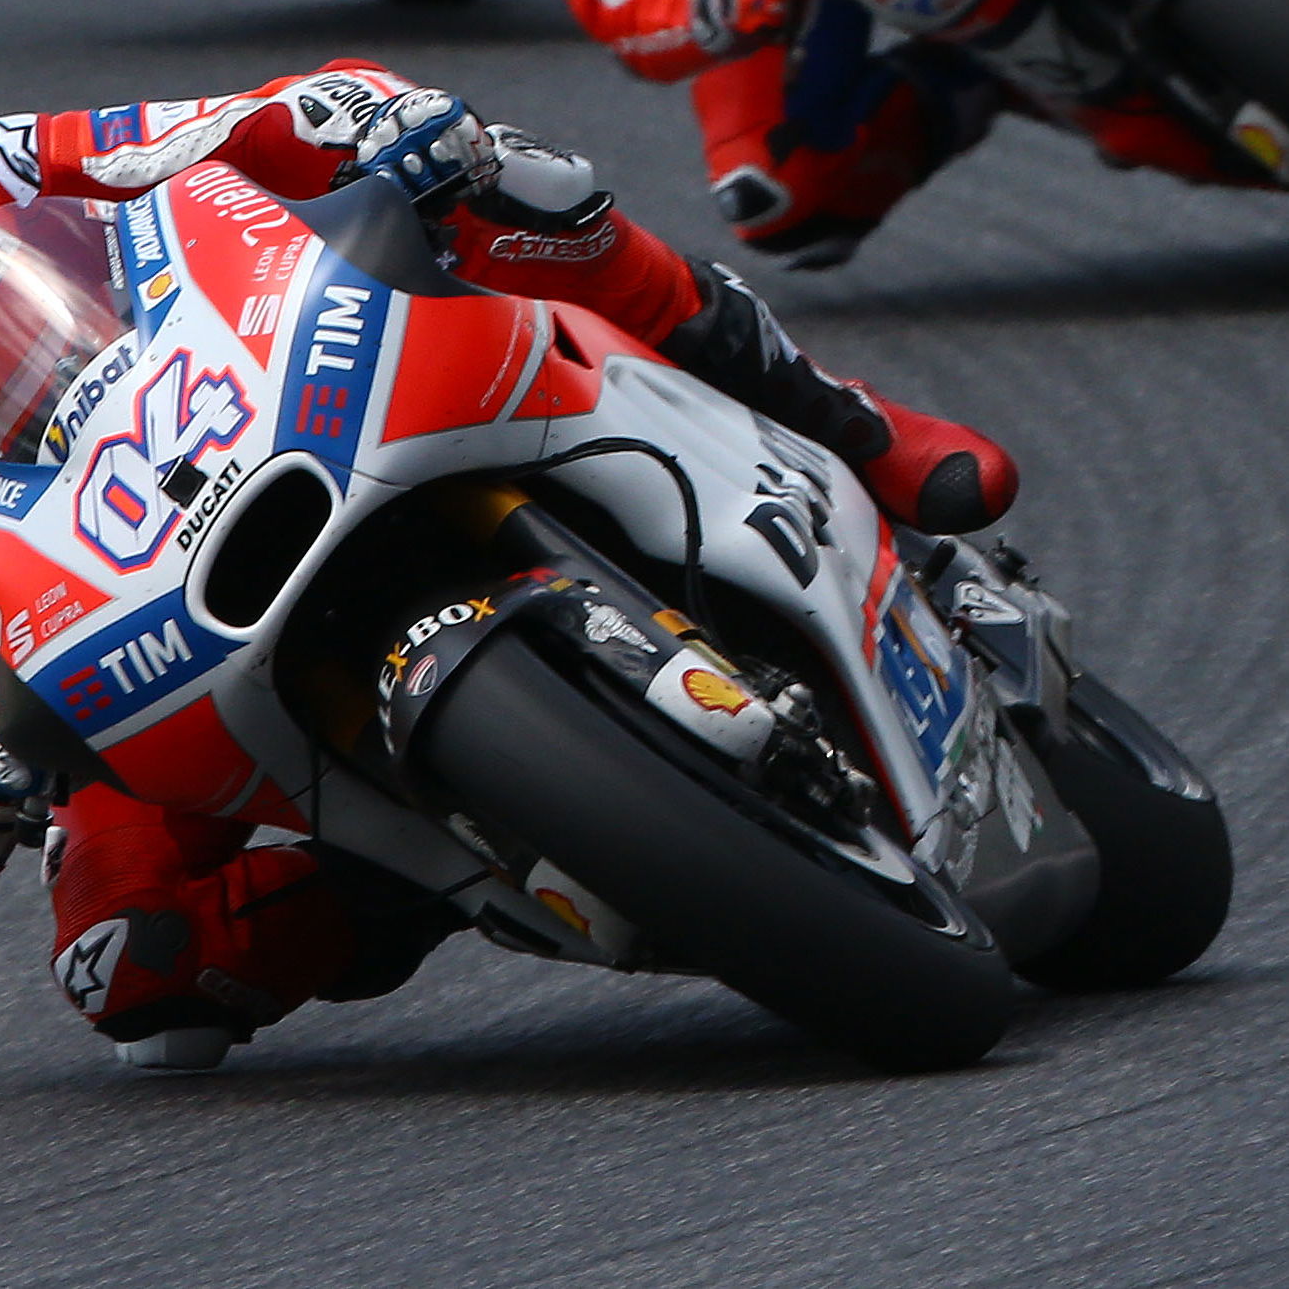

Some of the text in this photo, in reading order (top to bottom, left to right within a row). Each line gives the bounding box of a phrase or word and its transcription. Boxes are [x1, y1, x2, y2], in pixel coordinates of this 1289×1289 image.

[252, 245, 279, 282] LEON
[274, 233, 309, 281] CUPRA
[304, 284, 372, 376] TIM
[45, 343, 135, 464] Unibat
[72, 346, 259, 576] 04
[175, 457, 245, 553] DUCATI
[98, 617, 194, 695] TIM
